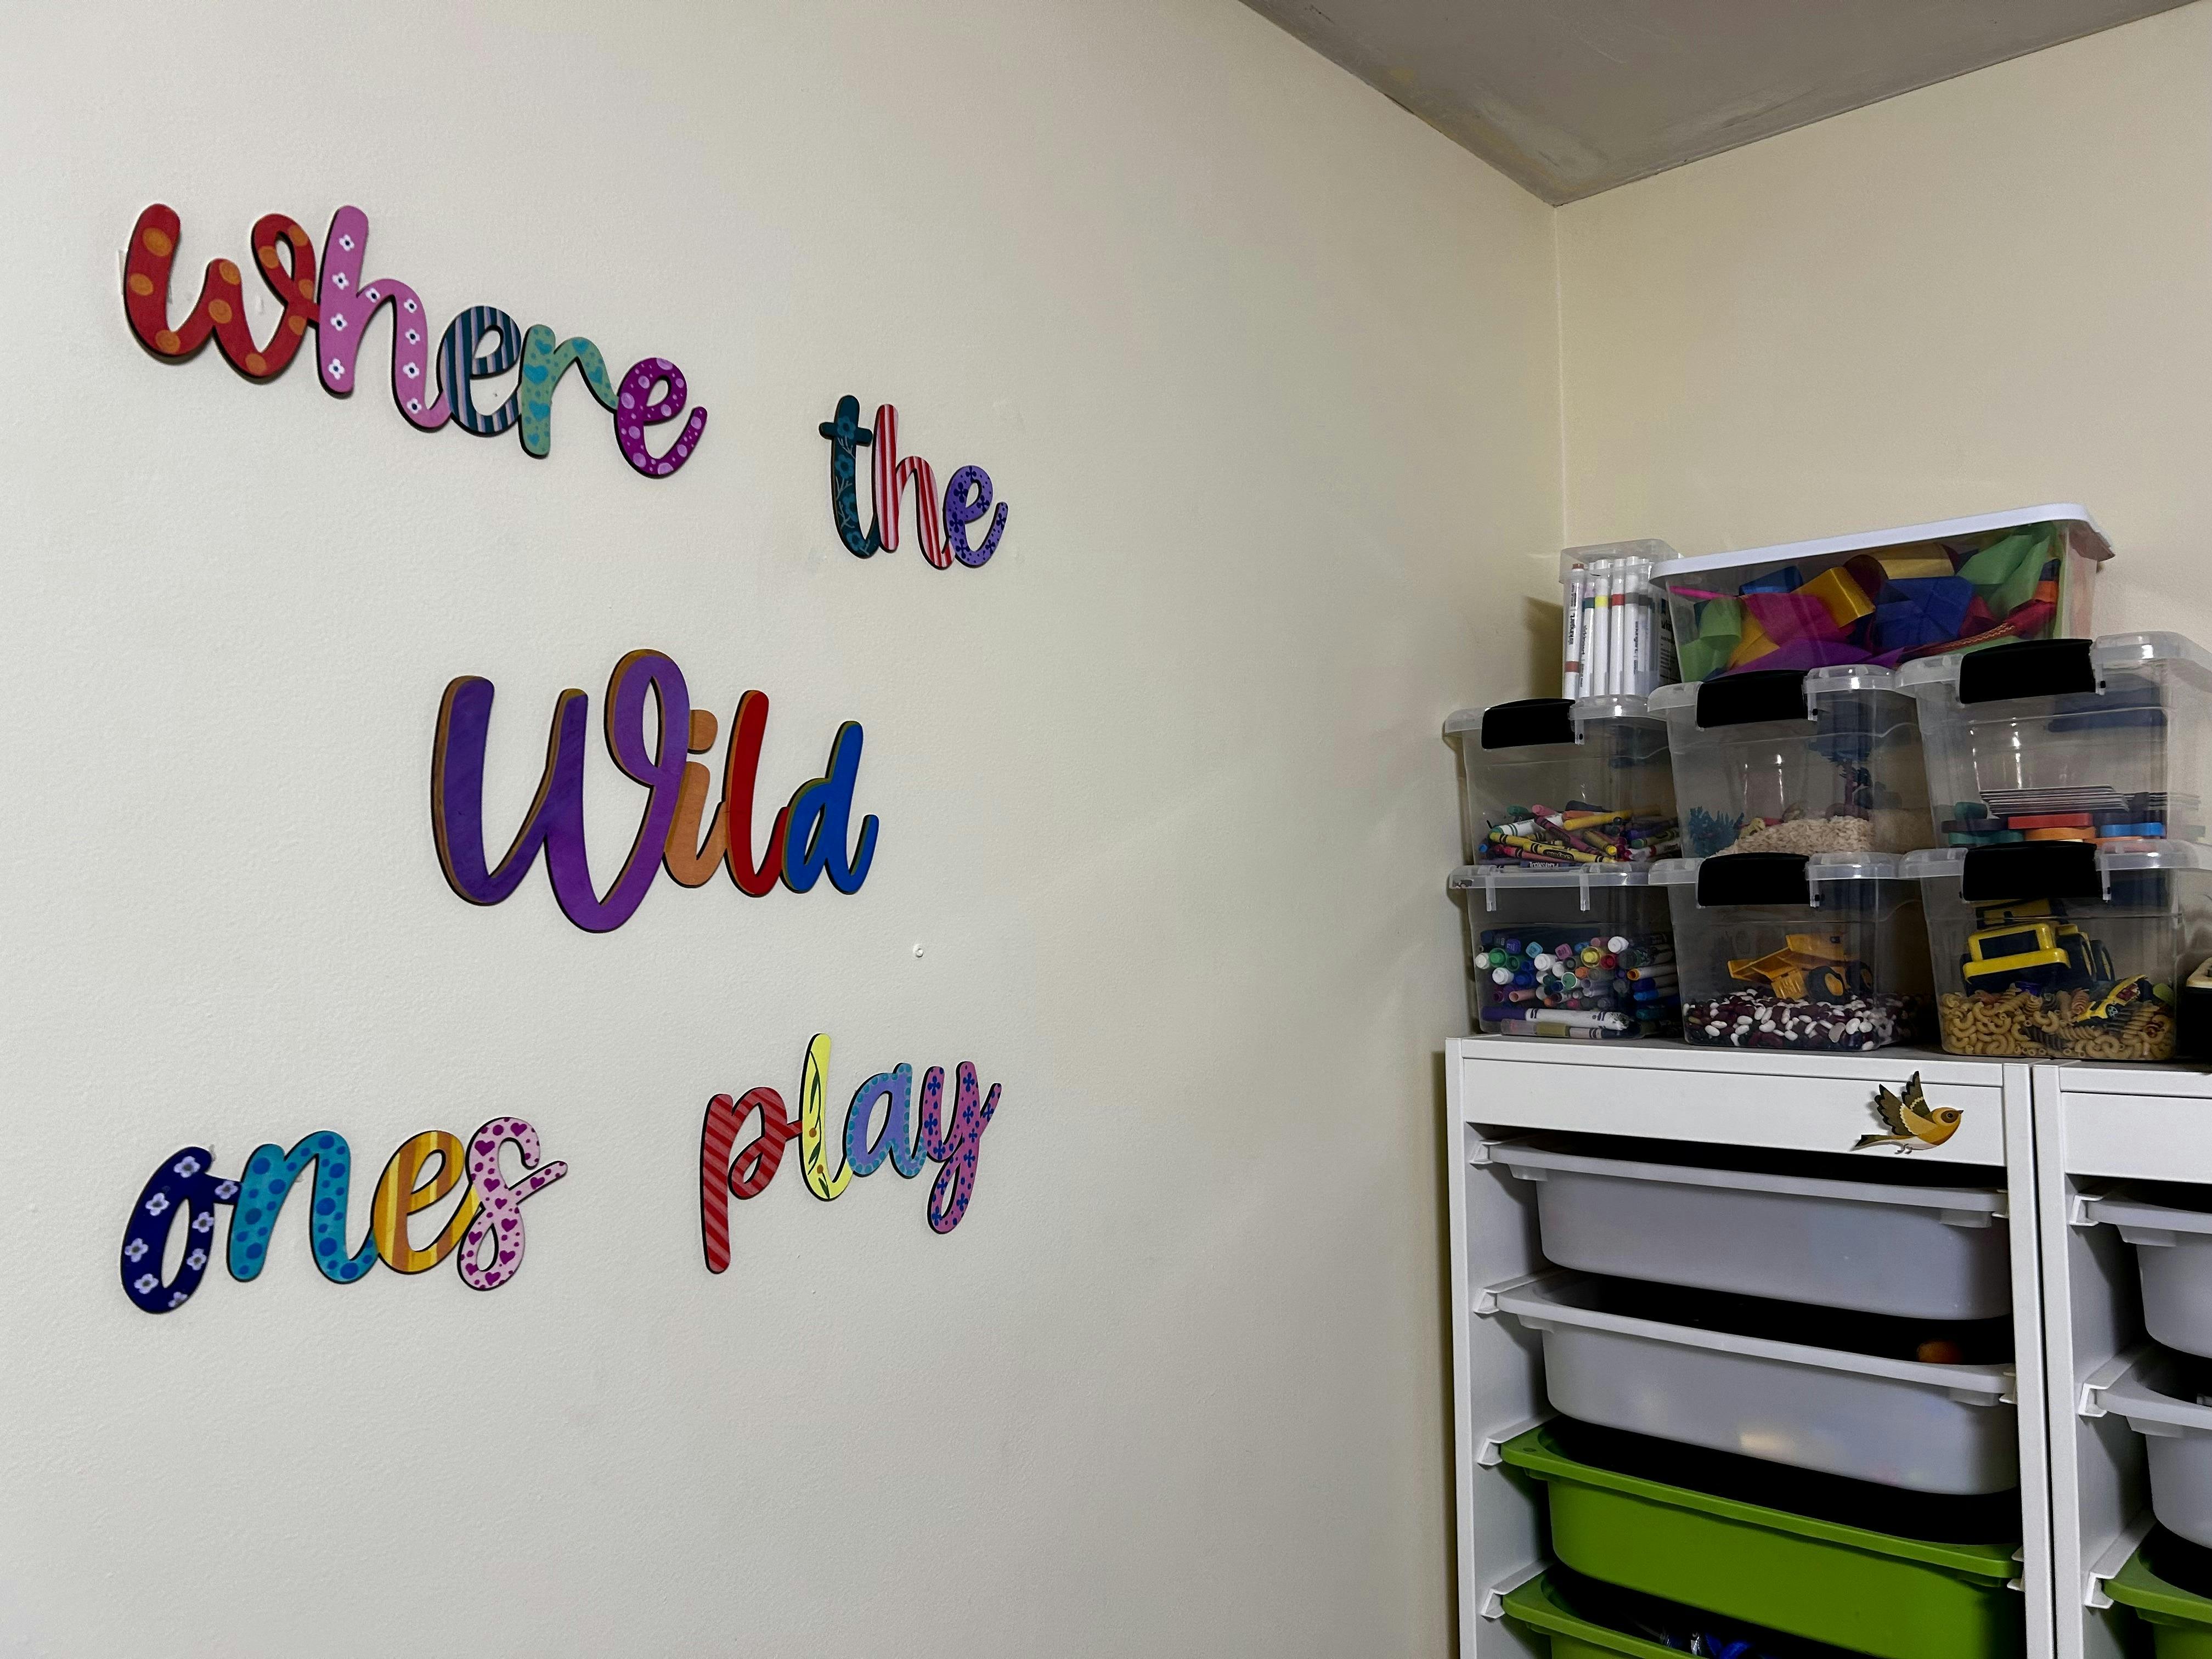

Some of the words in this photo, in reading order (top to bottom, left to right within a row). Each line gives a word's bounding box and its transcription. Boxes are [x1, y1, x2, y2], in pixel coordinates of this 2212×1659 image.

[123, 204, 708, 478] where
[819, 395, 1008, 570] the
[431, 648, 879, 933] Wild
[120, 1117, 568, 1314] ones
[699, 1033, 1001, 1274] play
